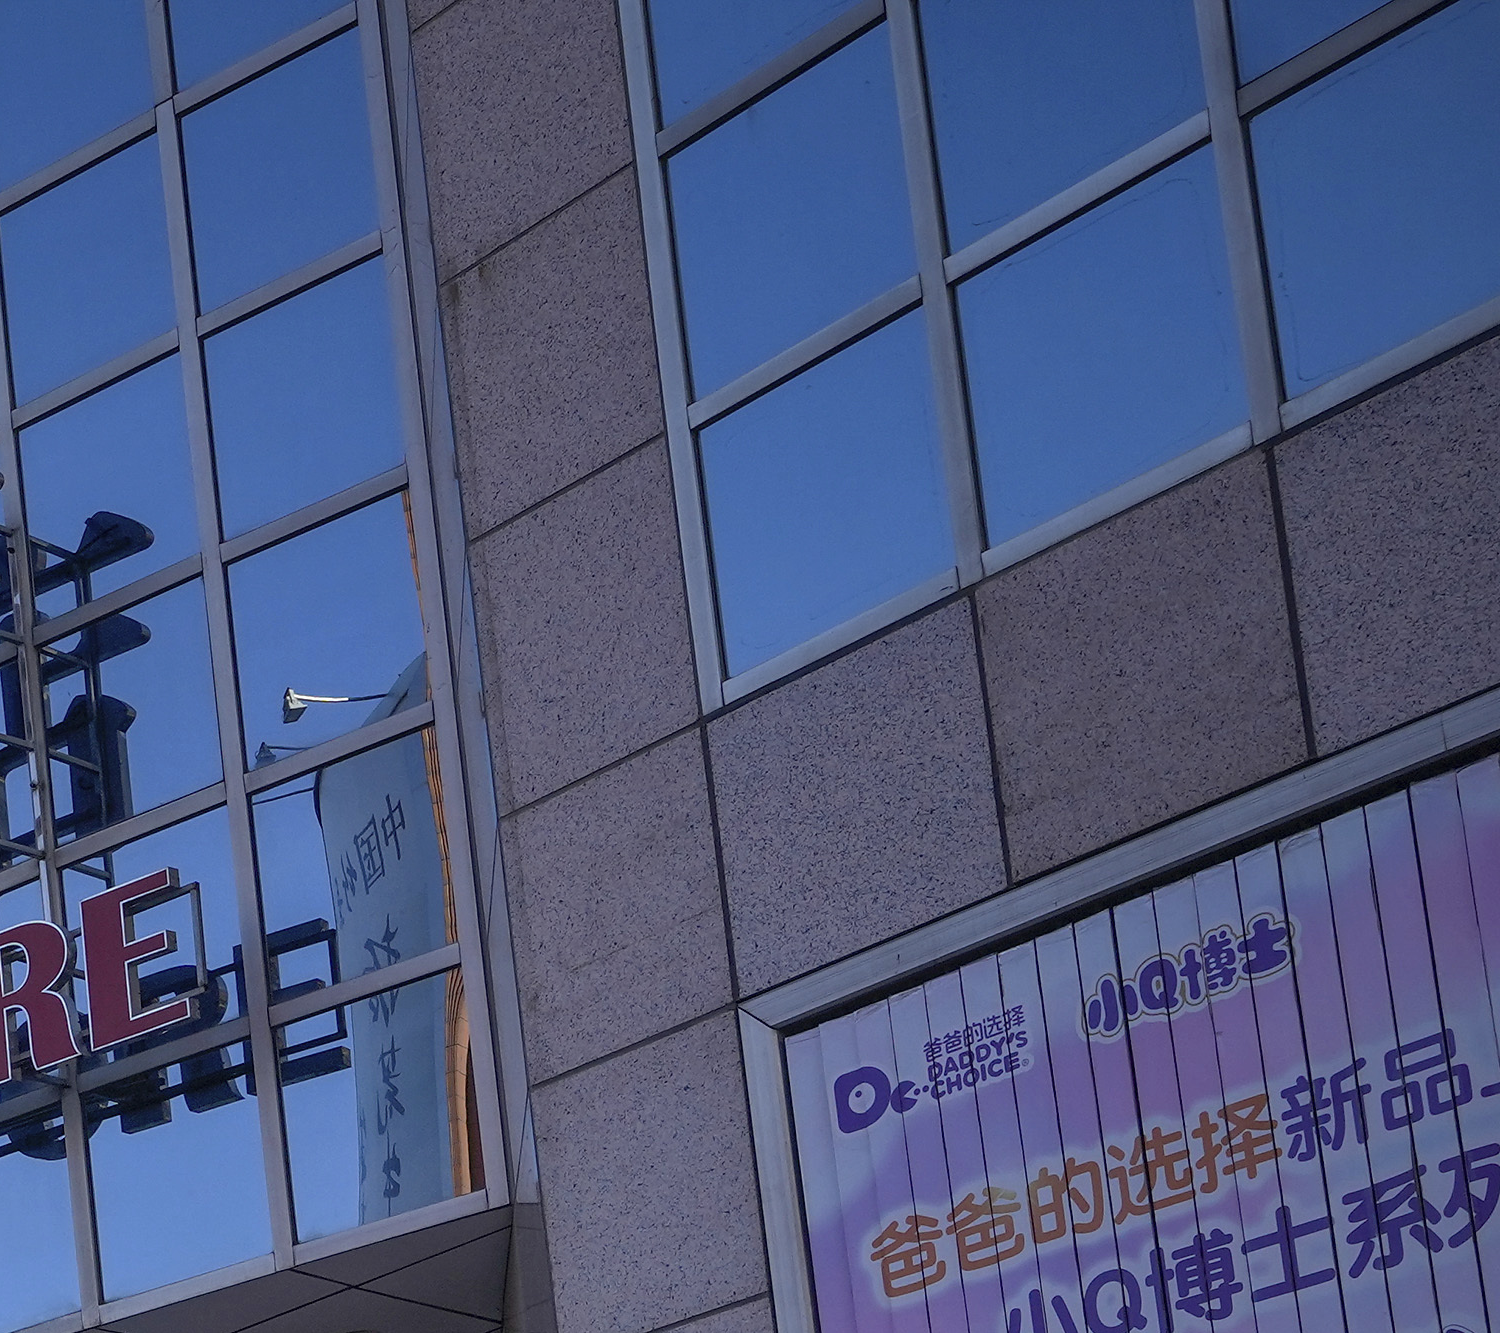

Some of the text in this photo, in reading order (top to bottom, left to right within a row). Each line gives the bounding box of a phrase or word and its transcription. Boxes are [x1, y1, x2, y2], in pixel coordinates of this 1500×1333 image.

[1087, 918, 1288, 1032] 小Q博士
[924, 1005, 1025, 1062] 爸爸的选择
[928, 1031, 1028, 1082] DADDY'S
[931, 1052, 1020, 1099] CHOICE
[870, 1028, 1500, 1298] 爸爸的选择新品
